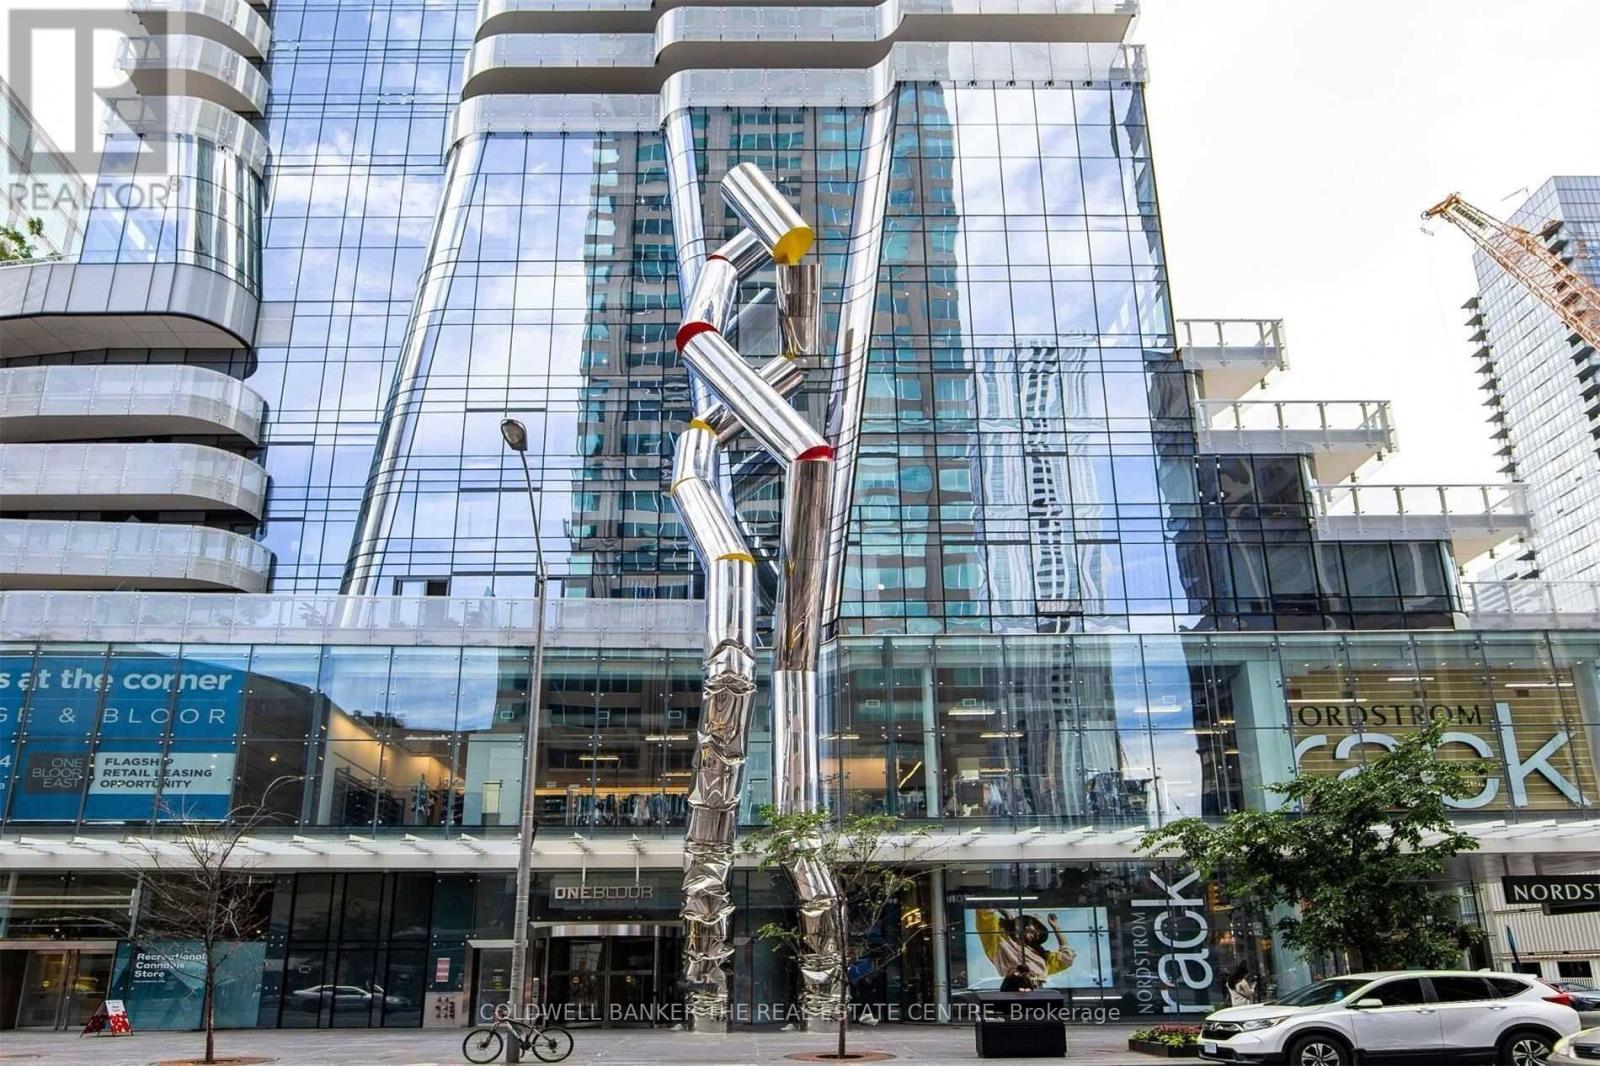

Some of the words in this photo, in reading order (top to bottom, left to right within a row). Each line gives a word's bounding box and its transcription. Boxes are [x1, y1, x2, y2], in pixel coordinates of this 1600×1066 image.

[18, 669, 51, 690] at
[61, 668, 113, 690] the
[123, 673, 232, 690] corner
[59, 707, 75, 723] &
[103, 708, 226, 724] BLOOR
[1286, 704, 1483, 727] ORDSTROM
[51, 758, 82, 768] ONE
[104, 758, 174, 767] FLAGSHP
[32, 768, 82, 778] BLOOR
[103, 769, 151, 778] RETAIL
[155, 769, 213, 778] LEASING
[43, 778, 80, 788] EAST
[100, 780, 192, 789] OPPORTUNITY
[1131, 869, 1216, 1014] rack
[136, 952, 206, 961] Recreational
[1131, 911, 1155, 1014] NORDSTROM
[134, 970, 166, 978] Store
